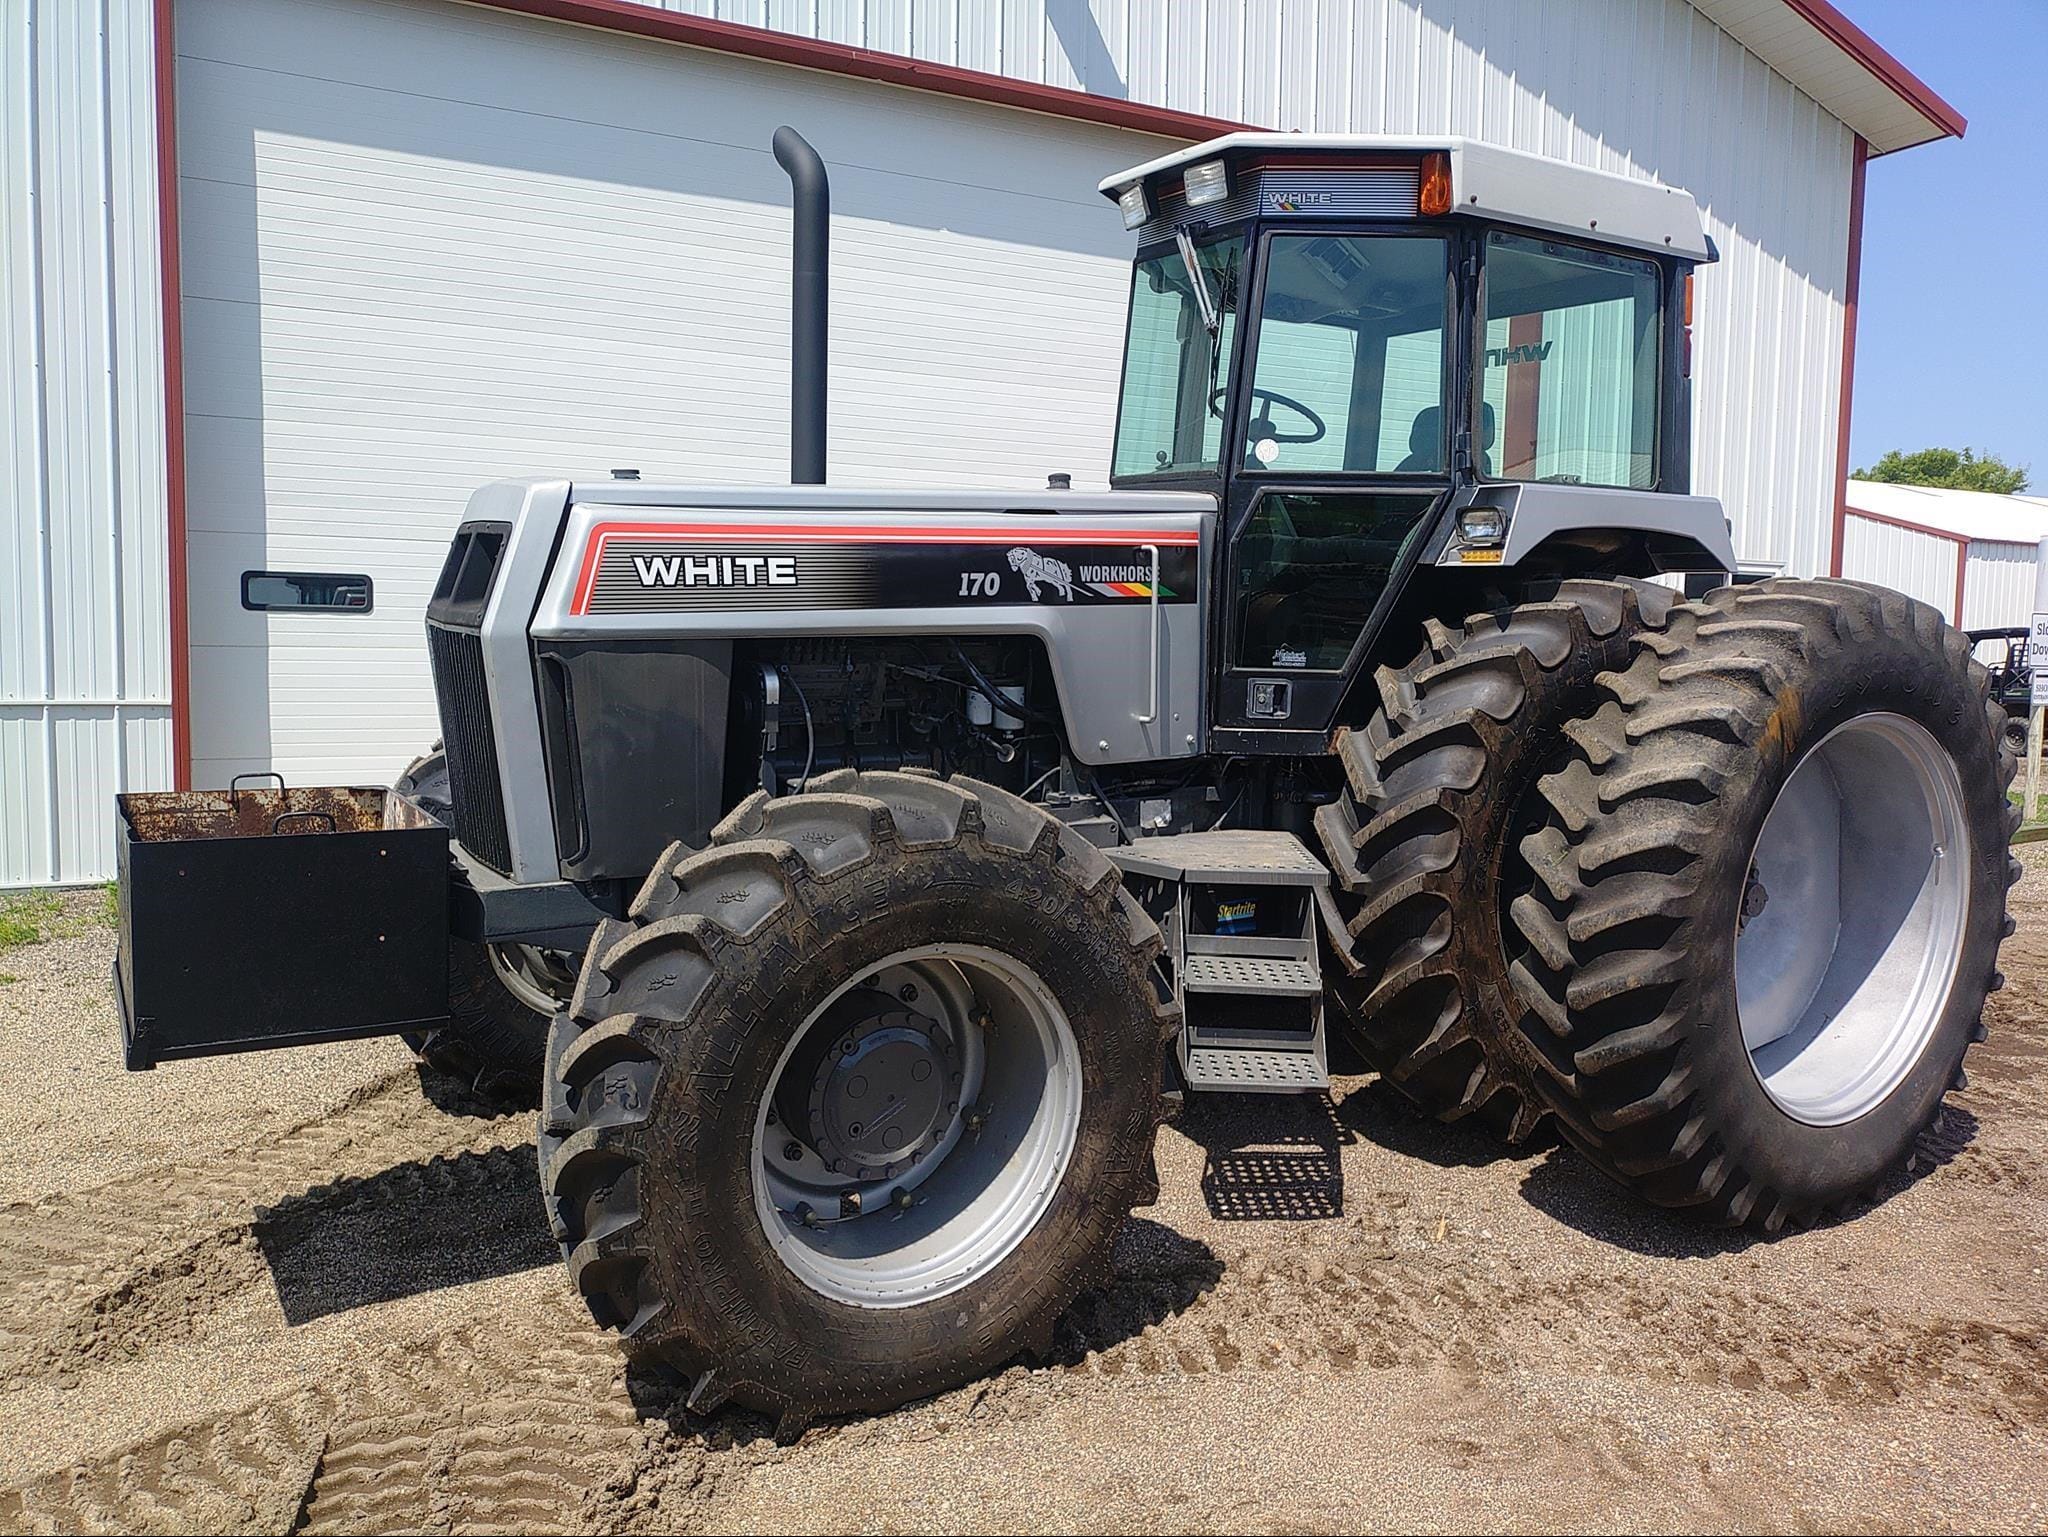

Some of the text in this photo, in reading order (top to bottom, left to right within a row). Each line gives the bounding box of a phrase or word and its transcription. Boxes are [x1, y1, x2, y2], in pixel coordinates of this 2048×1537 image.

[1268, 192, 1332, 203] WHITE
[630, 555, 799, 588] WHITE
[1079, 565, 1161, 582] WORKHORS
[958, 572, 1001, 597] 170
[1217, 901, 1256, 917] Startrite
